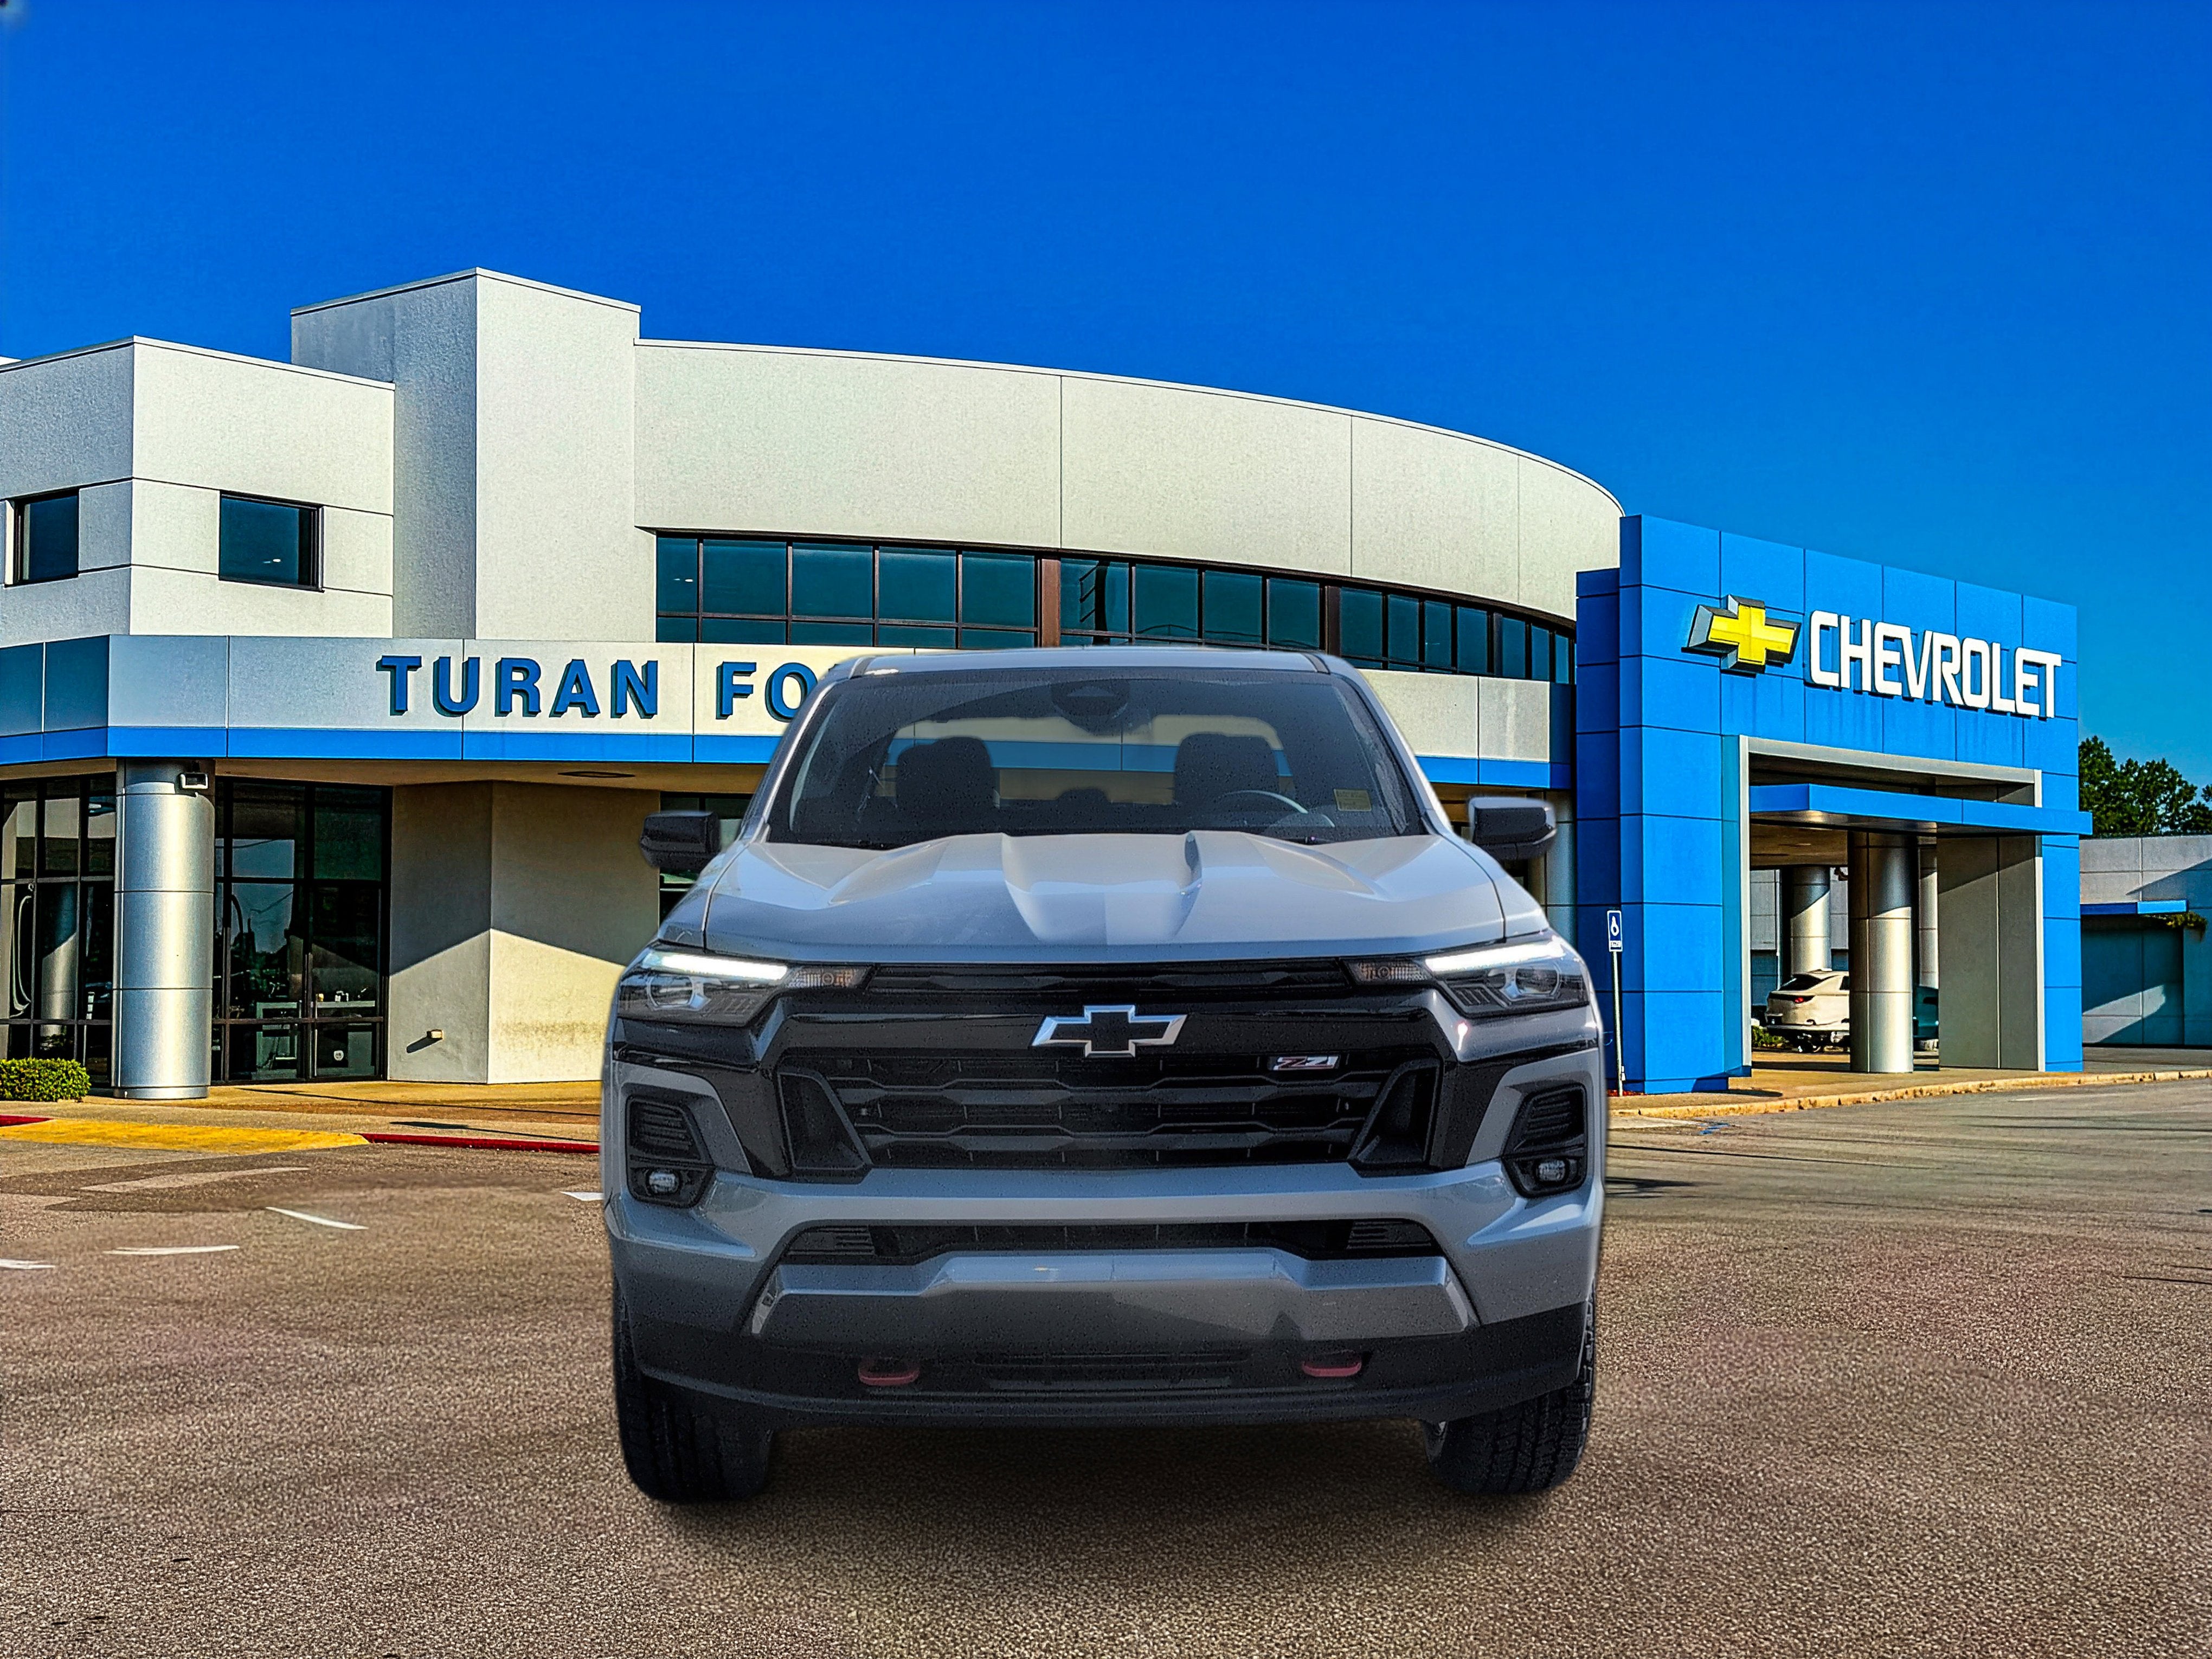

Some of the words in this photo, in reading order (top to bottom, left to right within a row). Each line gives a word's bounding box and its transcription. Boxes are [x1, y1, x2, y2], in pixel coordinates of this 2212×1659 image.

[376, 655, 658, 719] TURAN
[716, 661, 831, 723] FO
[1809, 610, 2062, 718] CHEVROLET
